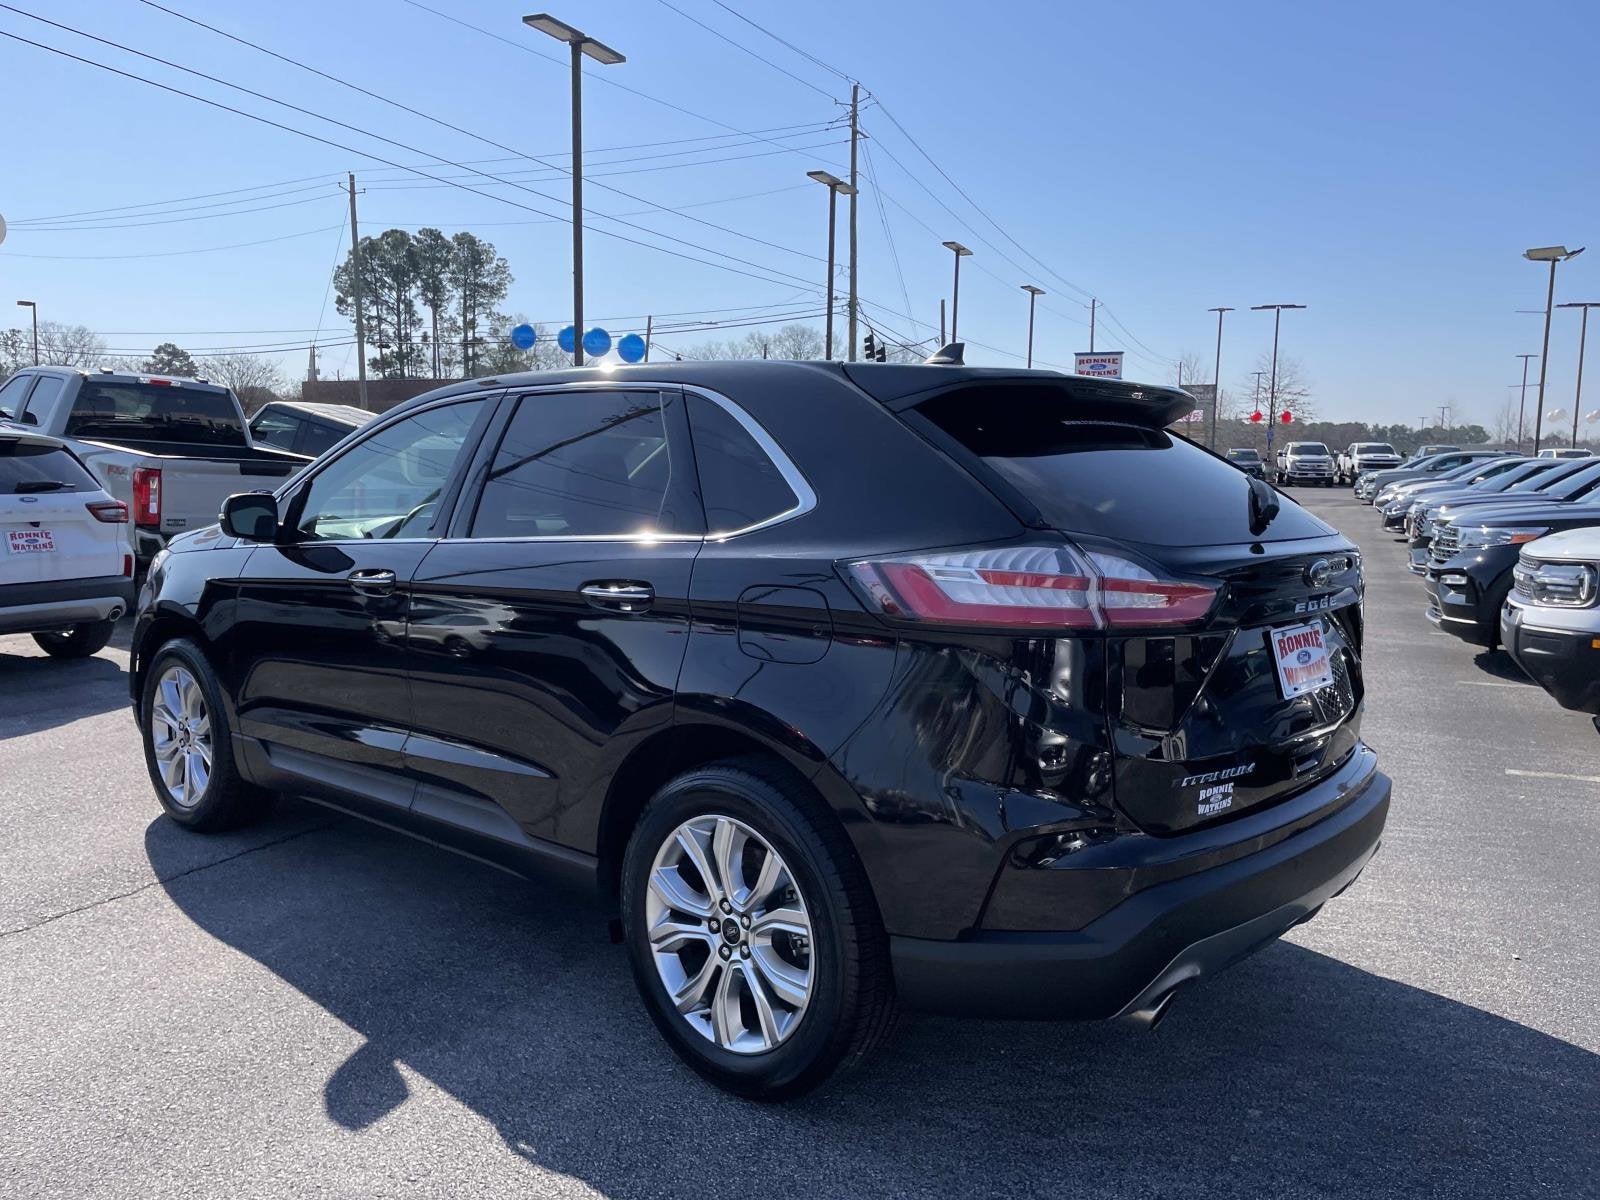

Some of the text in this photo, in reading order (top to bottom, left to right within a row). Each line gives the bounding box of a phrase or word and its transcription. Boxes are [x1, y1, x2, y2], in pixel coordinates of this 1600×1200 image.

[1078, 357, 1119, 365] RONNIE
[10, 531, 51, 541] RONNIE
[12, 541, 53, 550] WATKINS
[1294, 596, 1337, 613] EDGE
[1277, 629, 1322, 660] RONNIE
[1199, 782, 1234, 801] RONNIE
[1198, 796, 1232, 815] WATKINS
